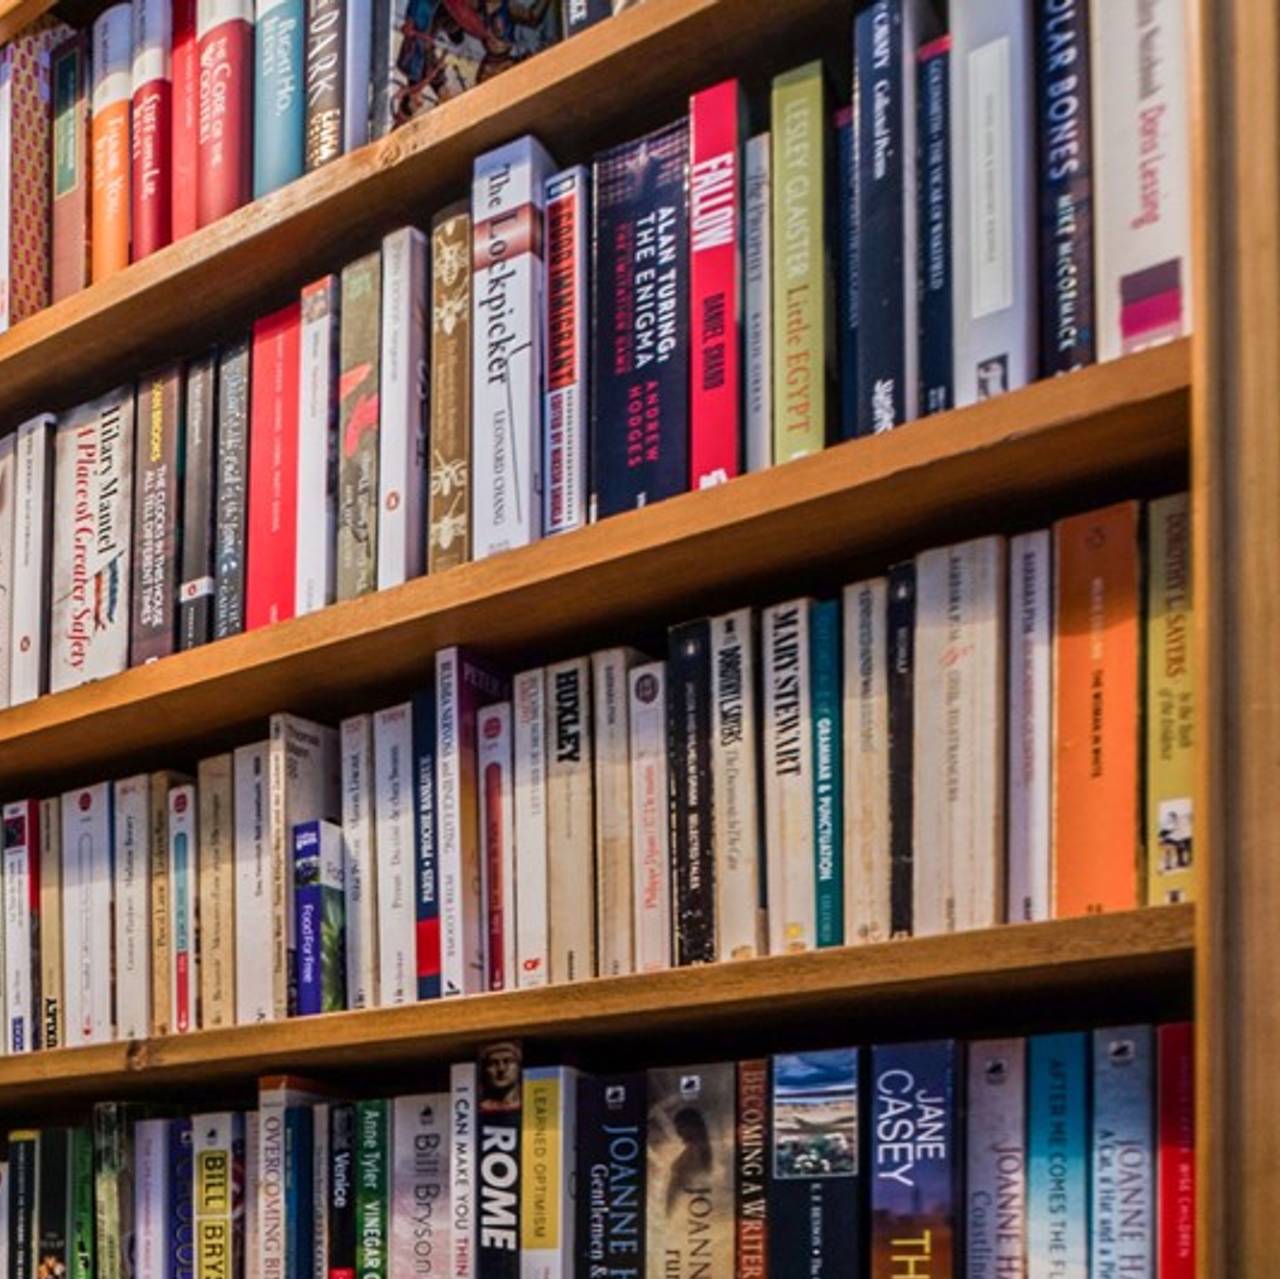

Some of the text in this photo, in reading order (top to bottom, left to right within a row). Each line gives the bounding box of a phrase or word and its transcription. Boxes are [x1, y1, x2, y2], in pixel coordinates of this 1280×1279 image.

[308, 10, 340, 106] DARK
[1048, 77, 1079, 181] BONES
[1130, 105, 1168, 231] Doris Lessing
[692, 152, 734, 251] FALLOW
[786, 98, 810, 279] LESLEY GLAISTER
[479, 164, 521, 385] The Lockpicker
[615, 251, 629, 331] IMITATION
[635, 212, 656, 368] THE ENIGMA
[657, 207, 677, 362] ALAN TURING:
[748, 204, 766, 284] PROPHET
[1056, 195, 1077, 352] MIKE McCORMACK
[548, 267, 577, 384] IMMIGRANT
[702, 293, 725, 390] DANIEL SHAND
[786, 286, 810, 434] Little EGYPT
[149, 408, 163, 462] BROOKS
[550, 393, 565, 427] EDITED
[627, 386, 642, 466] HODGES
[645, 381, 660, 461] ANDREW
[93, 406, 121, 554] Hilary Mantel
[492, 410, 507, 526] LEONARD CHANG
[65, 443, 96, 670] Place Greater Safety
[141, 523, 155, 625] DIFFERENT TIMES
[151, 465, 168, 627] THE CLOCKS THIS HOUSE
[774, 609, 802, 777] MARY STEWART
[1166, 613, 1187, 678] SAYERS
[555, 669, 581, 764] HUXLEY
[1091, 670, 1104, 778] THE WOMAN WHITE
[816, 717, 833, 881] GRAMMAR PUNCTUATION
[302, 904, 316, 984] Food For Free
[362, 1110, 380, 1189] Anne Tyler
[533, 1087, 548, 1238] LEARNED OPTIMISM
[741, 1070, 768, 1279] BECOMING WRITER
[876, 1069, 915, 1186] CASEY
[916, 1089, 945, 1159] JANE
[203, 1155, 225, 1208] BILL
[262, 1116, 280, 1254] OVERCOMING
[333, 1152, 350, 1209] Venice
[410, 1132, 441, 1275] Bill Bryson
[456, 1099, 470, 1278] CAN MAKE YOU THIN
[481, 1125, 517, 1250] ROME
[589, 1163, 608, 1261] Gentlemen
[602, 1126, 639, 1254] JOANNE
[992, 1146, 1021, 1243] JOANNE
[1048, 1151, 1068, 1215] COMES
[1116, 1139, 1147, 1241] JOANNE
[363, 1200, 380, 1269] VINEGAR
[1048, 1220, 1068, 1254] THE
